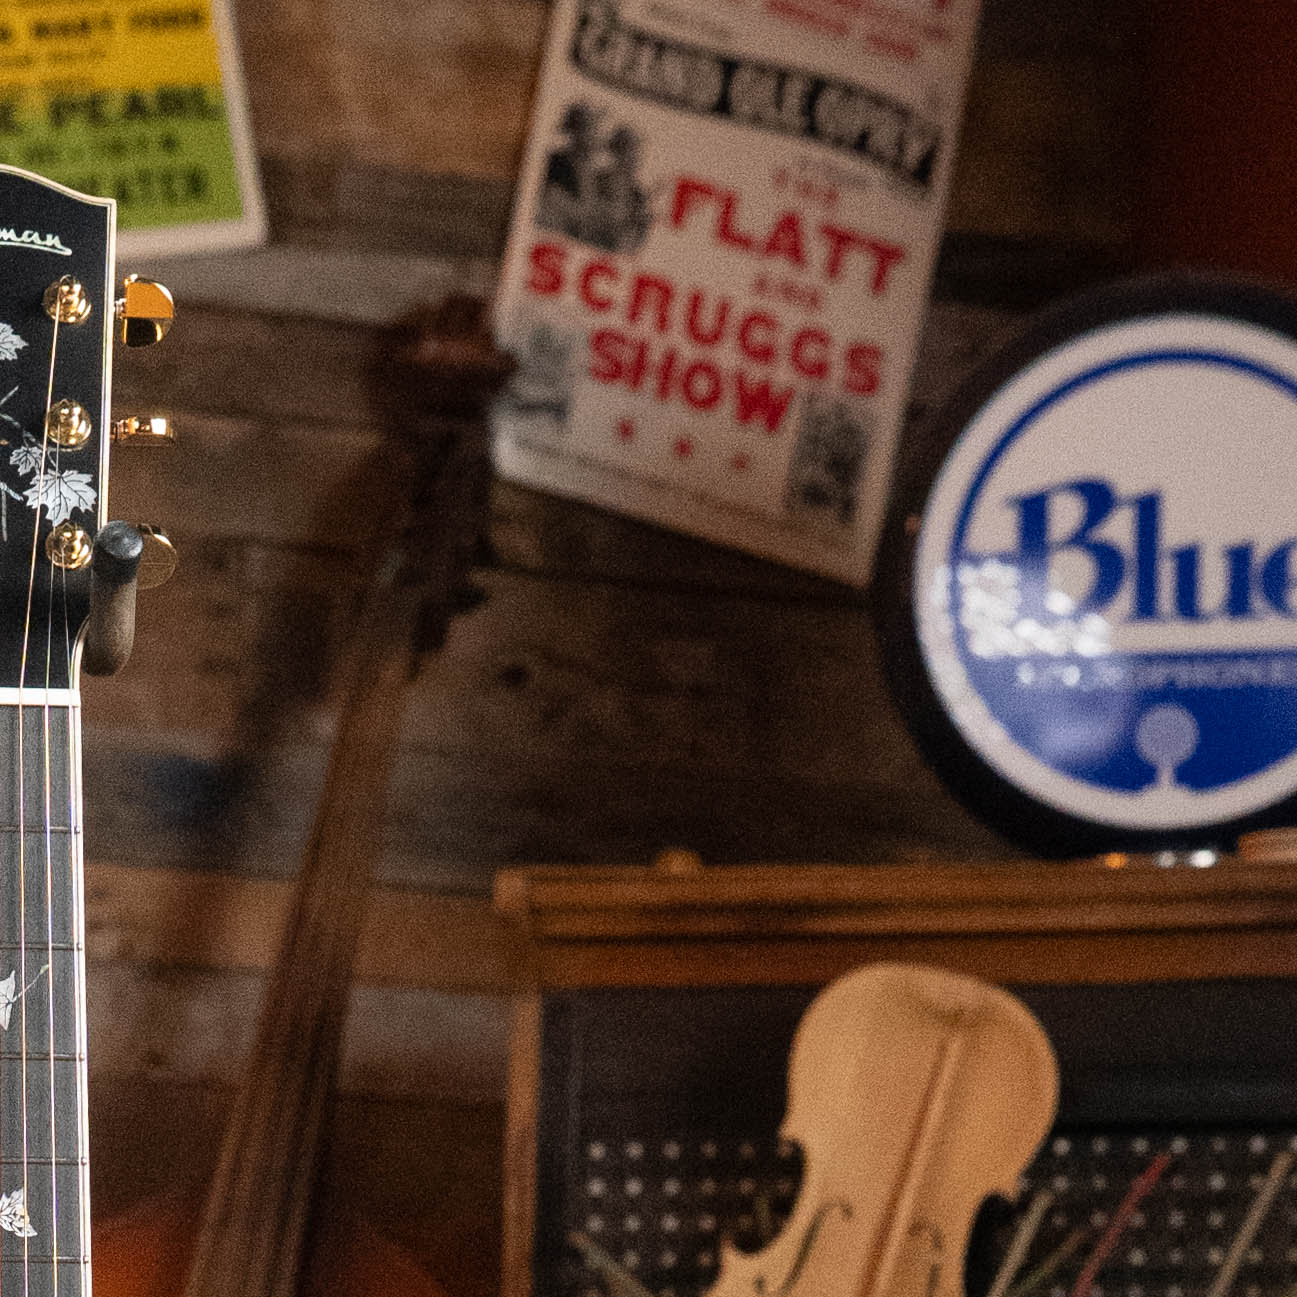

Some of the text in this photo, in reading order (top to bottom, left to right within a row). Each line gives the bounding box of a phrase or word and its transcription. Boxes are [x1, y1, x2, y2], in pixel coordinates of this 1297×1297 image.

[670, 175, 905, 297] FLATT
[527, 242, 884, 396] SCRUGGS
[588, 326, 796, 433] SHOW
